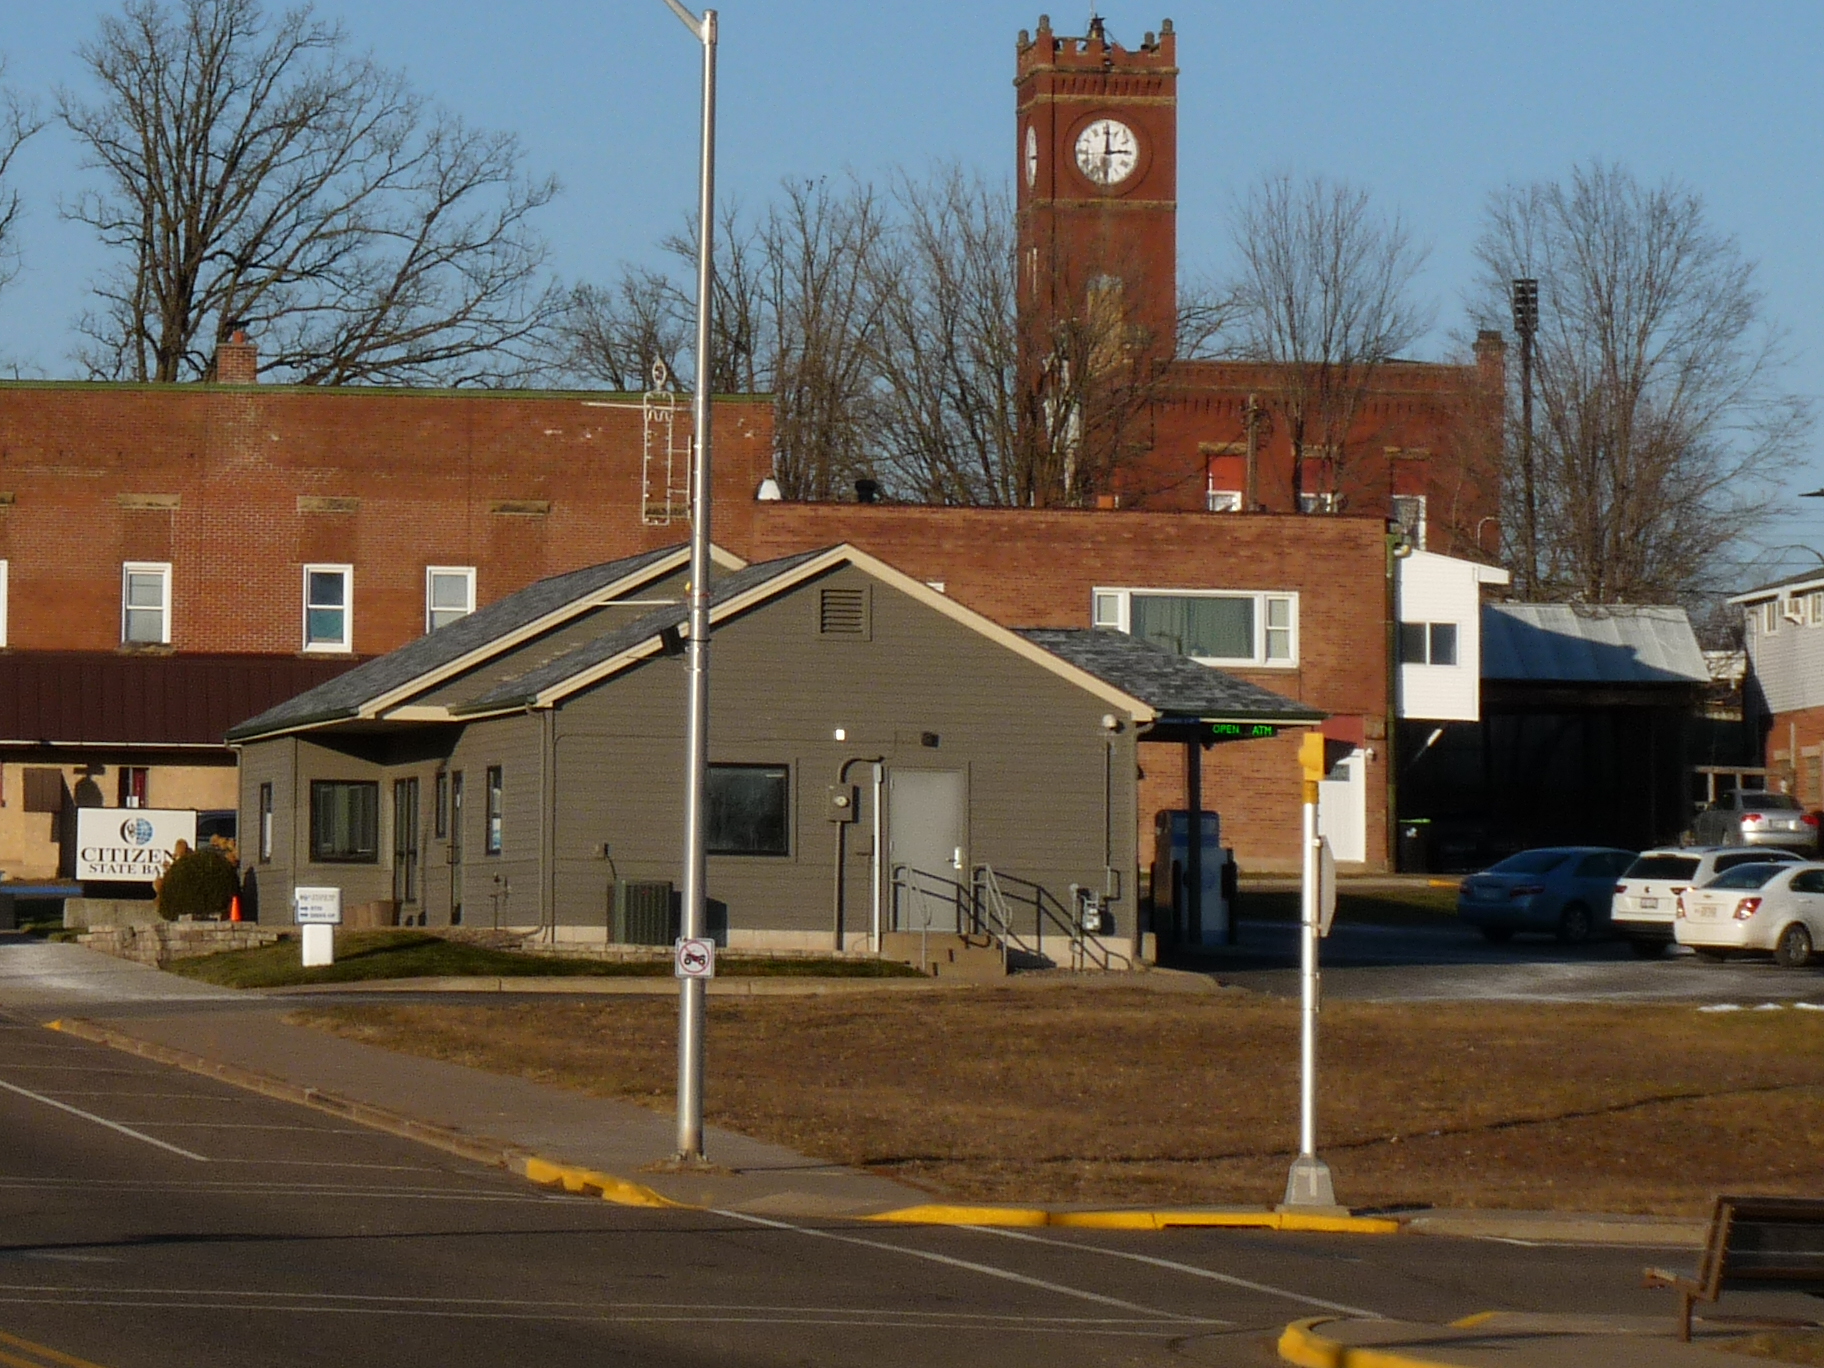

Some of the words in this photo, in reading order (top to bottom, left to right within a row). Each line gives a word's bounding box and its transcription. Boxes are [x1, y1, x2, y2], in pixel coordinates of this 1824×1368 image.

[1211, 723, 1240, 735] OPEN
[1251, 724, 1273, 736] ATM
[81, 847, 176, 863] CITIZEN
[88, 863, 136, 875] STATE
[142, 864, 161, 875] BA
